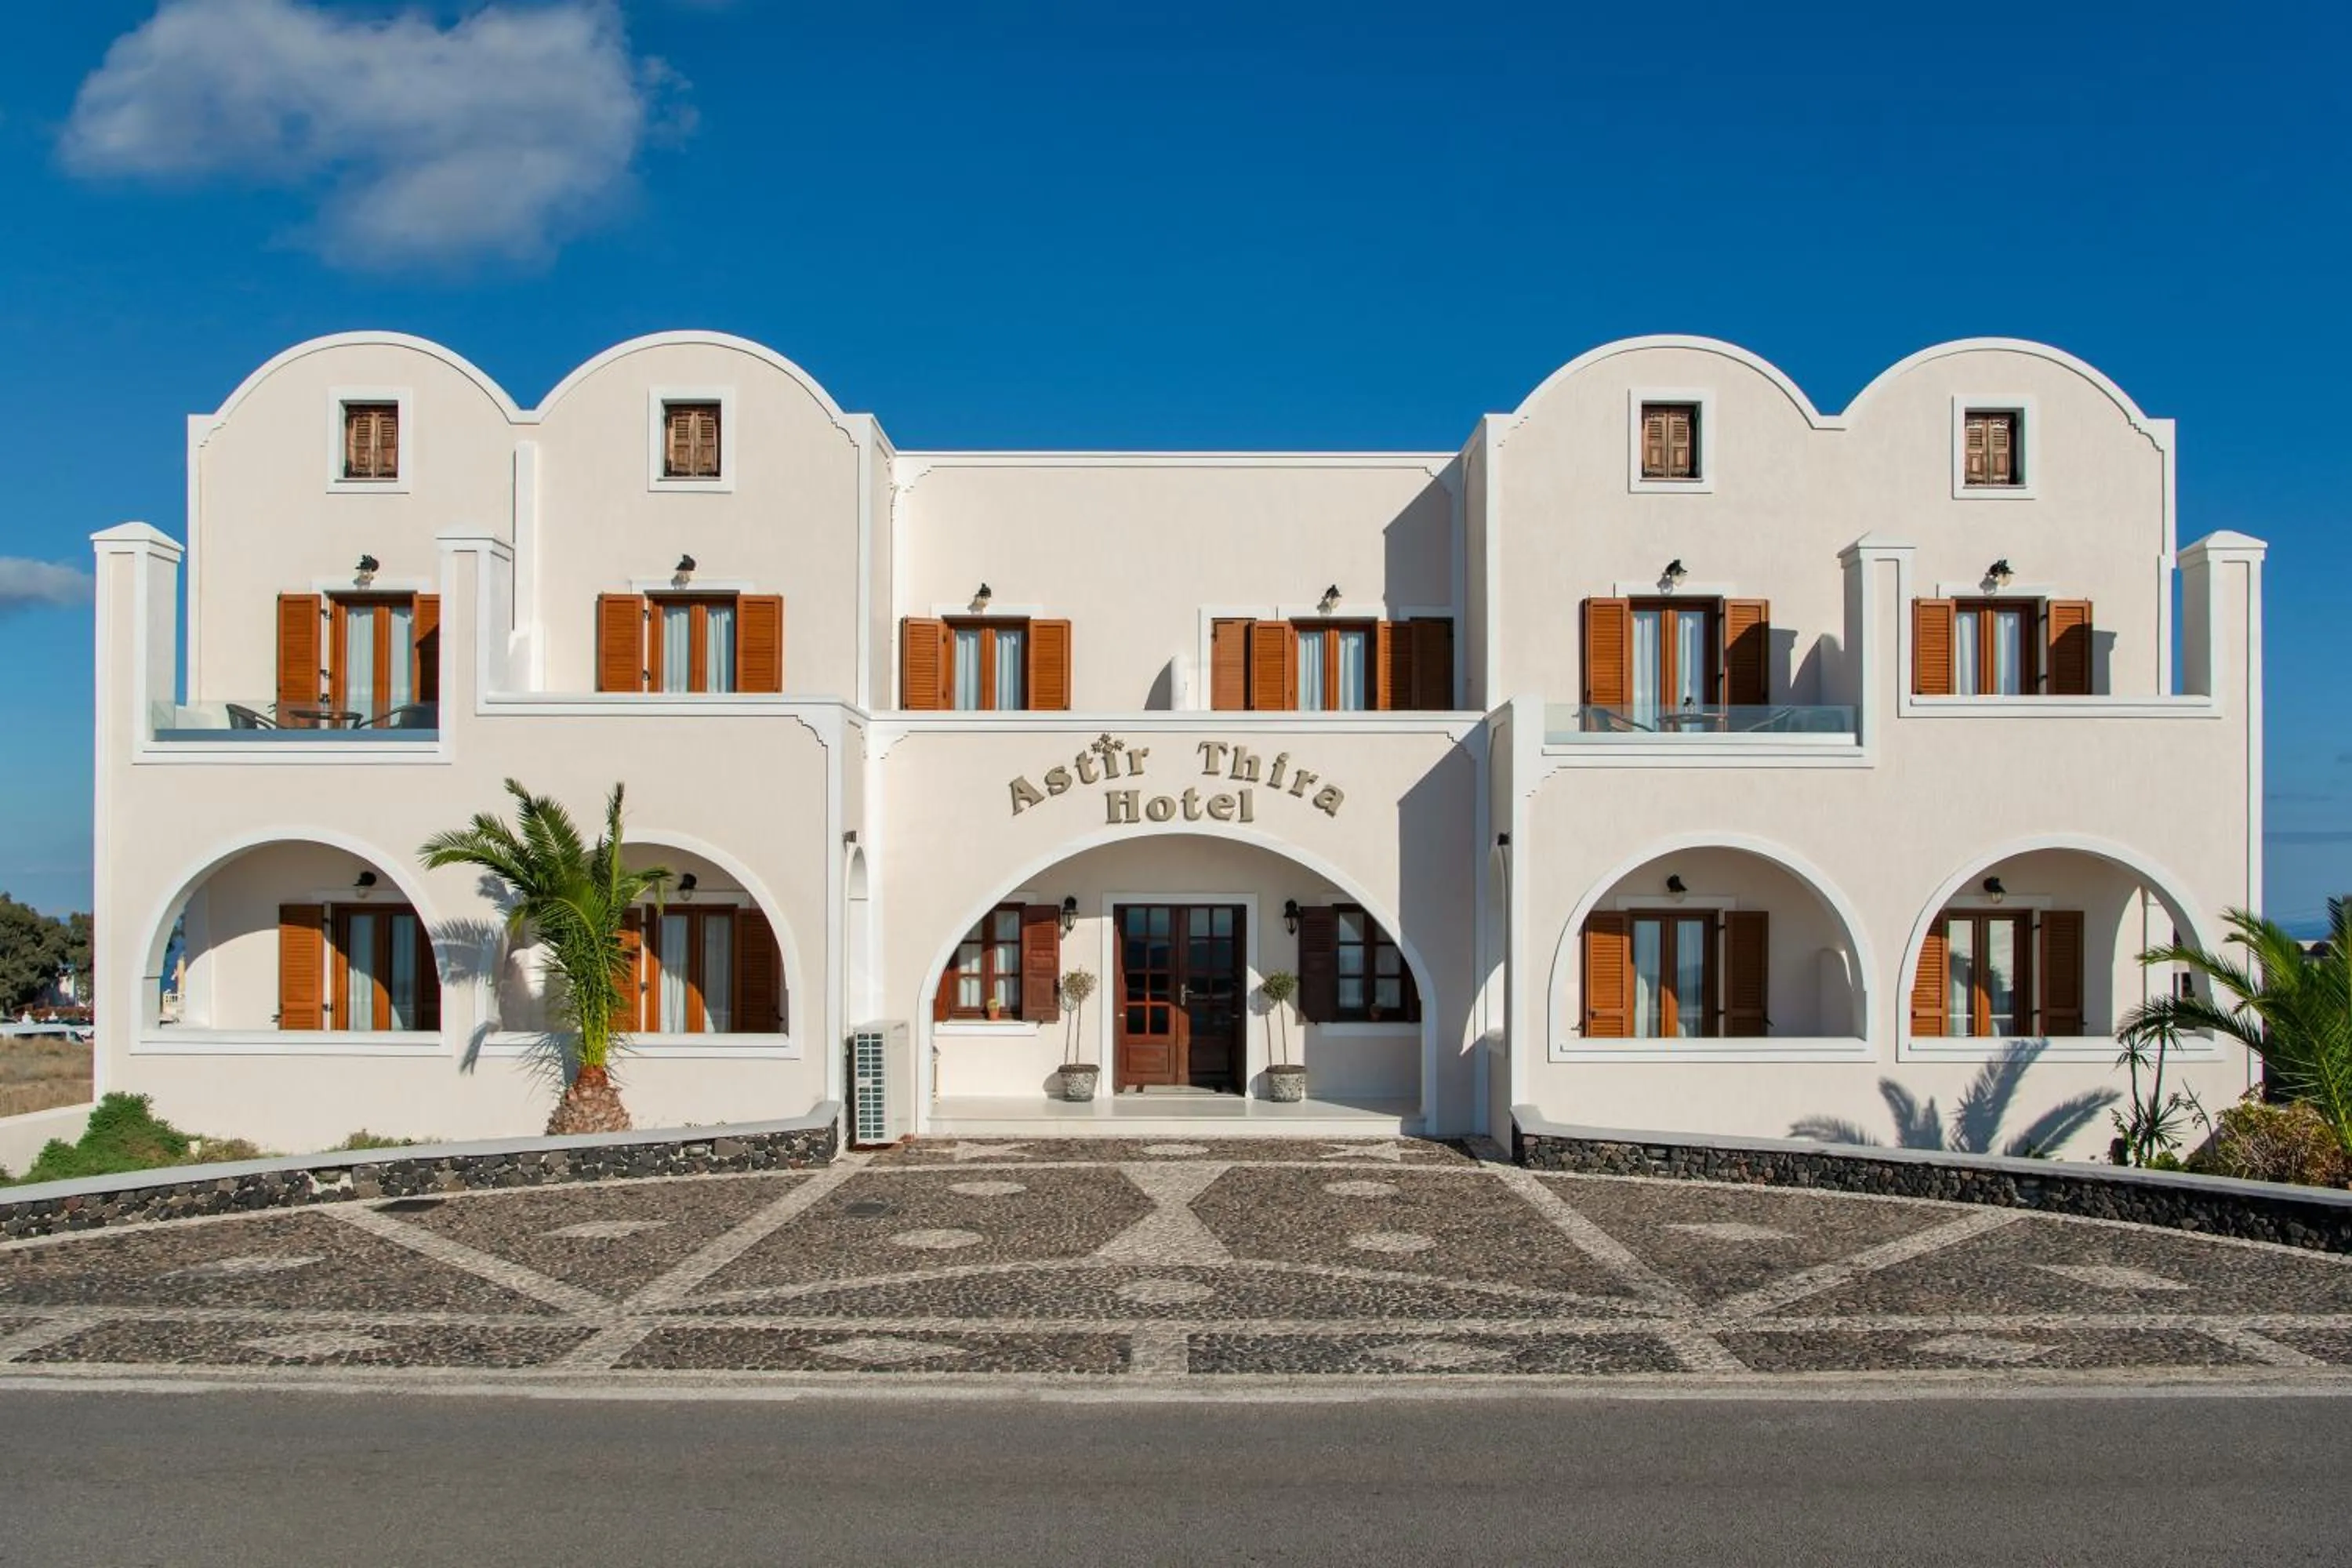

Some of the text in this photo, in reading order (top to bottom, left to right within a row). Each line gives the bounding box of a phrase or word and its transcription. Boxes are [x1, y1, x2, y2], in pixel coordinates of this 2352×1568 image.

[1007, 733, 1345, 818] Astir Thira
[1105, 786, 1254, 824] Hotel
